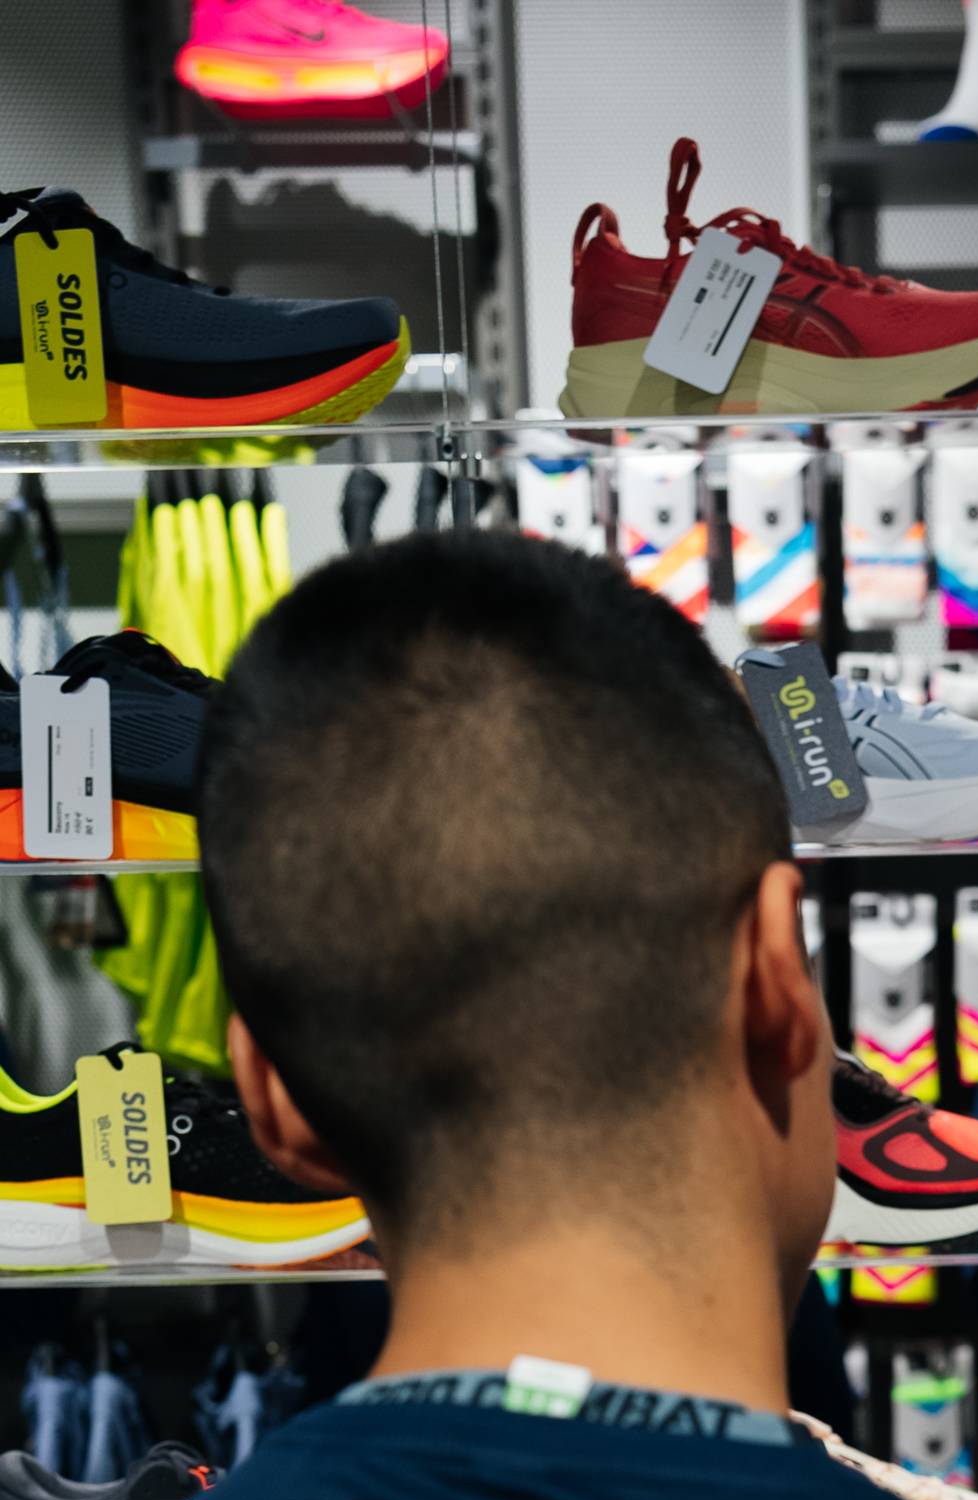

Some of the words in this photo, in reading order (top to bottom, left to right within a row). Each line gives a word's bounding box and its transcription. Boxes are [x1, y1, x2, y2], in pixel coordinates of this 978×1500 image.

[38, 320, 50, 352] i-run
[57, 273, 88, 381] SOLDES
[794, 717, 833, 787] i-run
[121, 1091, 152, 1186] SOLDES
